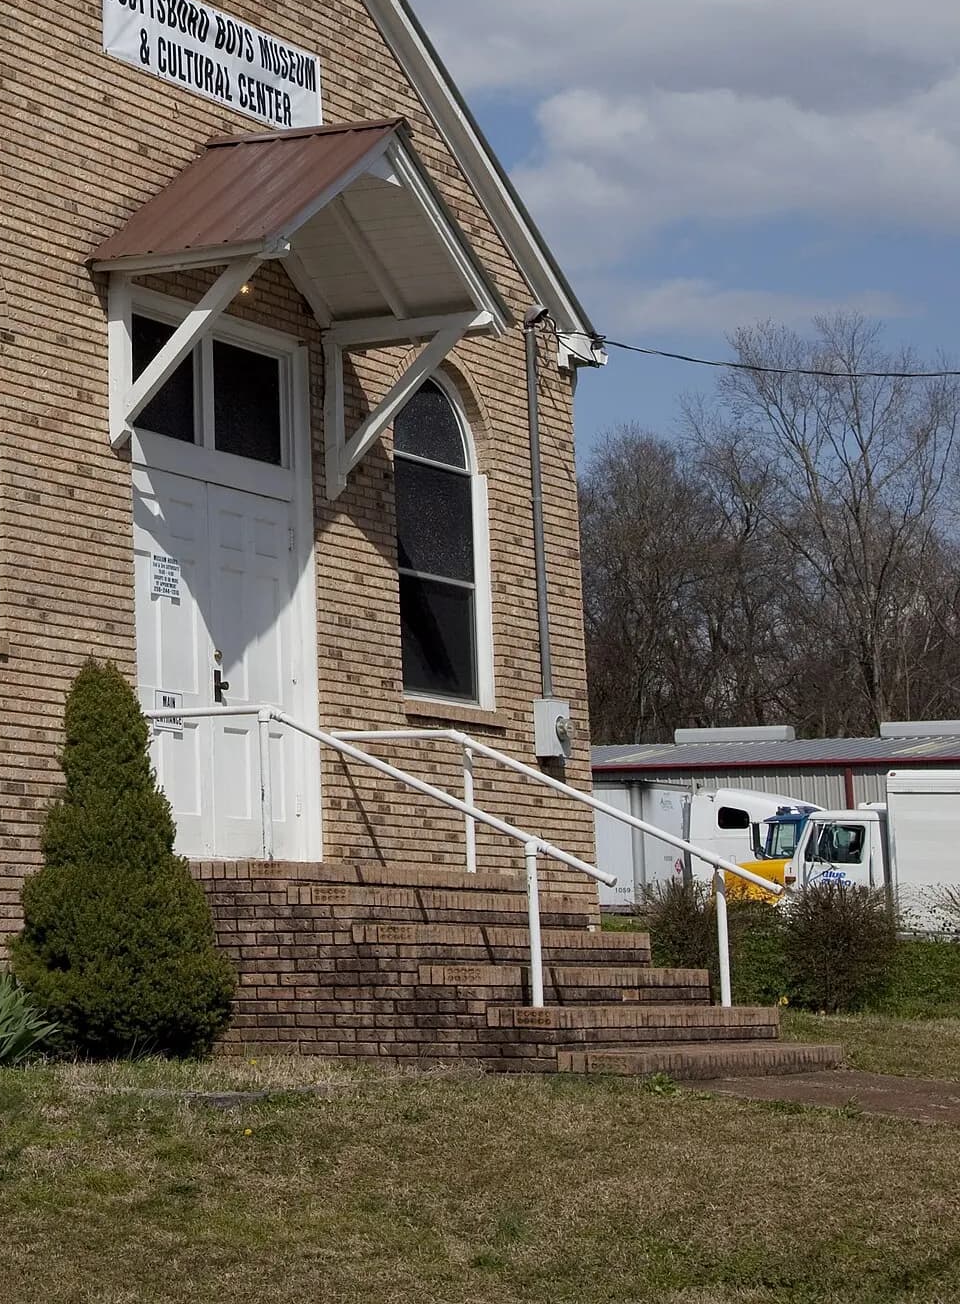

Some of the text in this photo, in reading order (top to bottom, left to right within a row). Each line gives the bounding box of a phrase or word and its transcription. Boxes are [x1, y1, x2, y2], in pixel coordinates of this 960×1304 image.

[140, 28, 292, 127] & CULTURAL CENTER
[215, 15, 254, 63] BOYS
[258, 35, 316, 93] MUSEUM
[163, 696, 175, 709] MAIN
